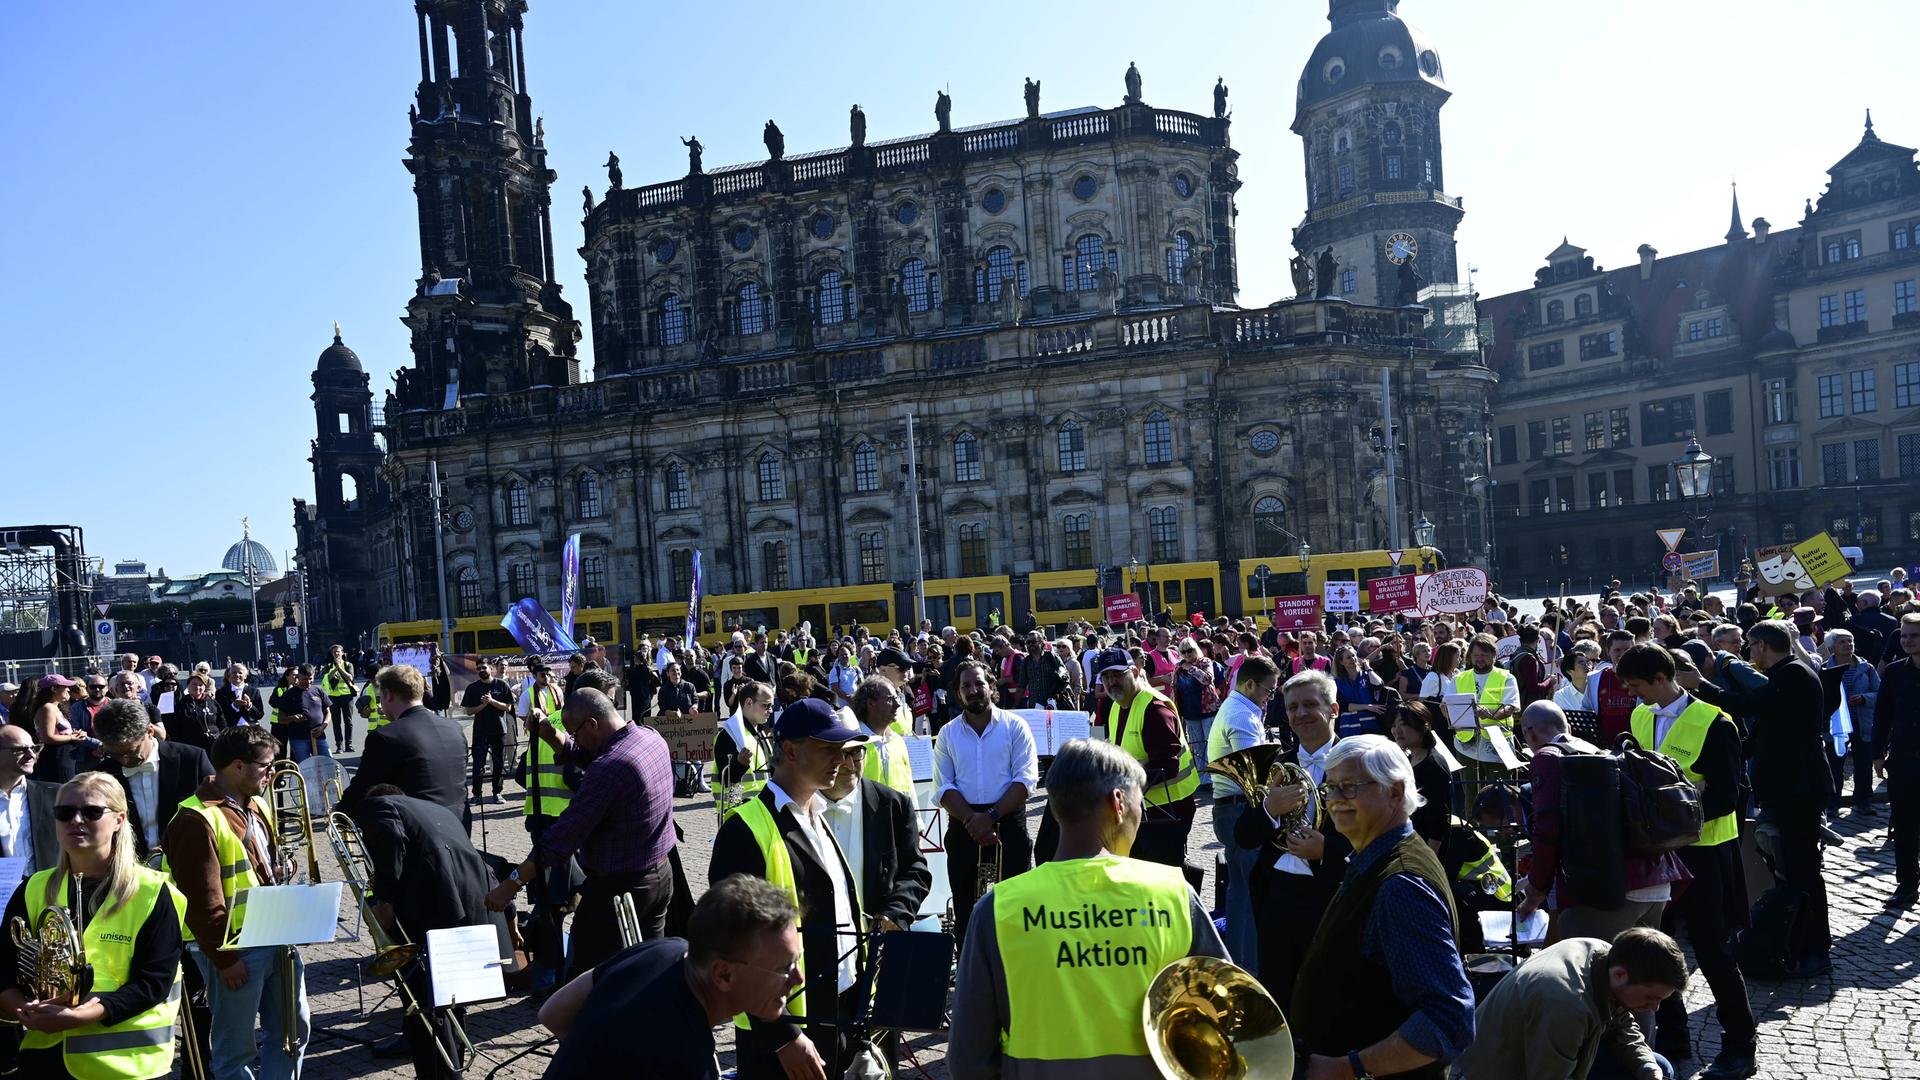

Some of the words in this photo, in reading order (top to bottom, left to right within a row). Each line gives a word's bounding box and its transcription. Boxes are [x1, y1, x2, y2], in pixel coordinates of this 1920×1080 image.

[1801, 547, 1820, 559] Kultur
[1814, 552, 1828, 563] kein
[1809, 560, 1828, 571] Luxus
[1432, 570, 1477, 583] THEATER
[1378, 585, 1406, 593] BRAUCHT
[1428, 584, 1440, 592] IST
[1444, 580, 1482, 589] BILDUNG
[1385, 591, 1410, 599] KULTUR!
[1438, 588, 1465, 597] KEINE
[1279, 600, 1317, 608] STANDORT-
[1431, 594, 1484, 606] BUDGETLÜCKE
[1283, 608, 1313, 616] VORTEIL!
[1023, 902, 1171, 932] Musiker:in
[100, 932, 132, 942] unisono
[1057, 940, 1147, 968] Aktion
